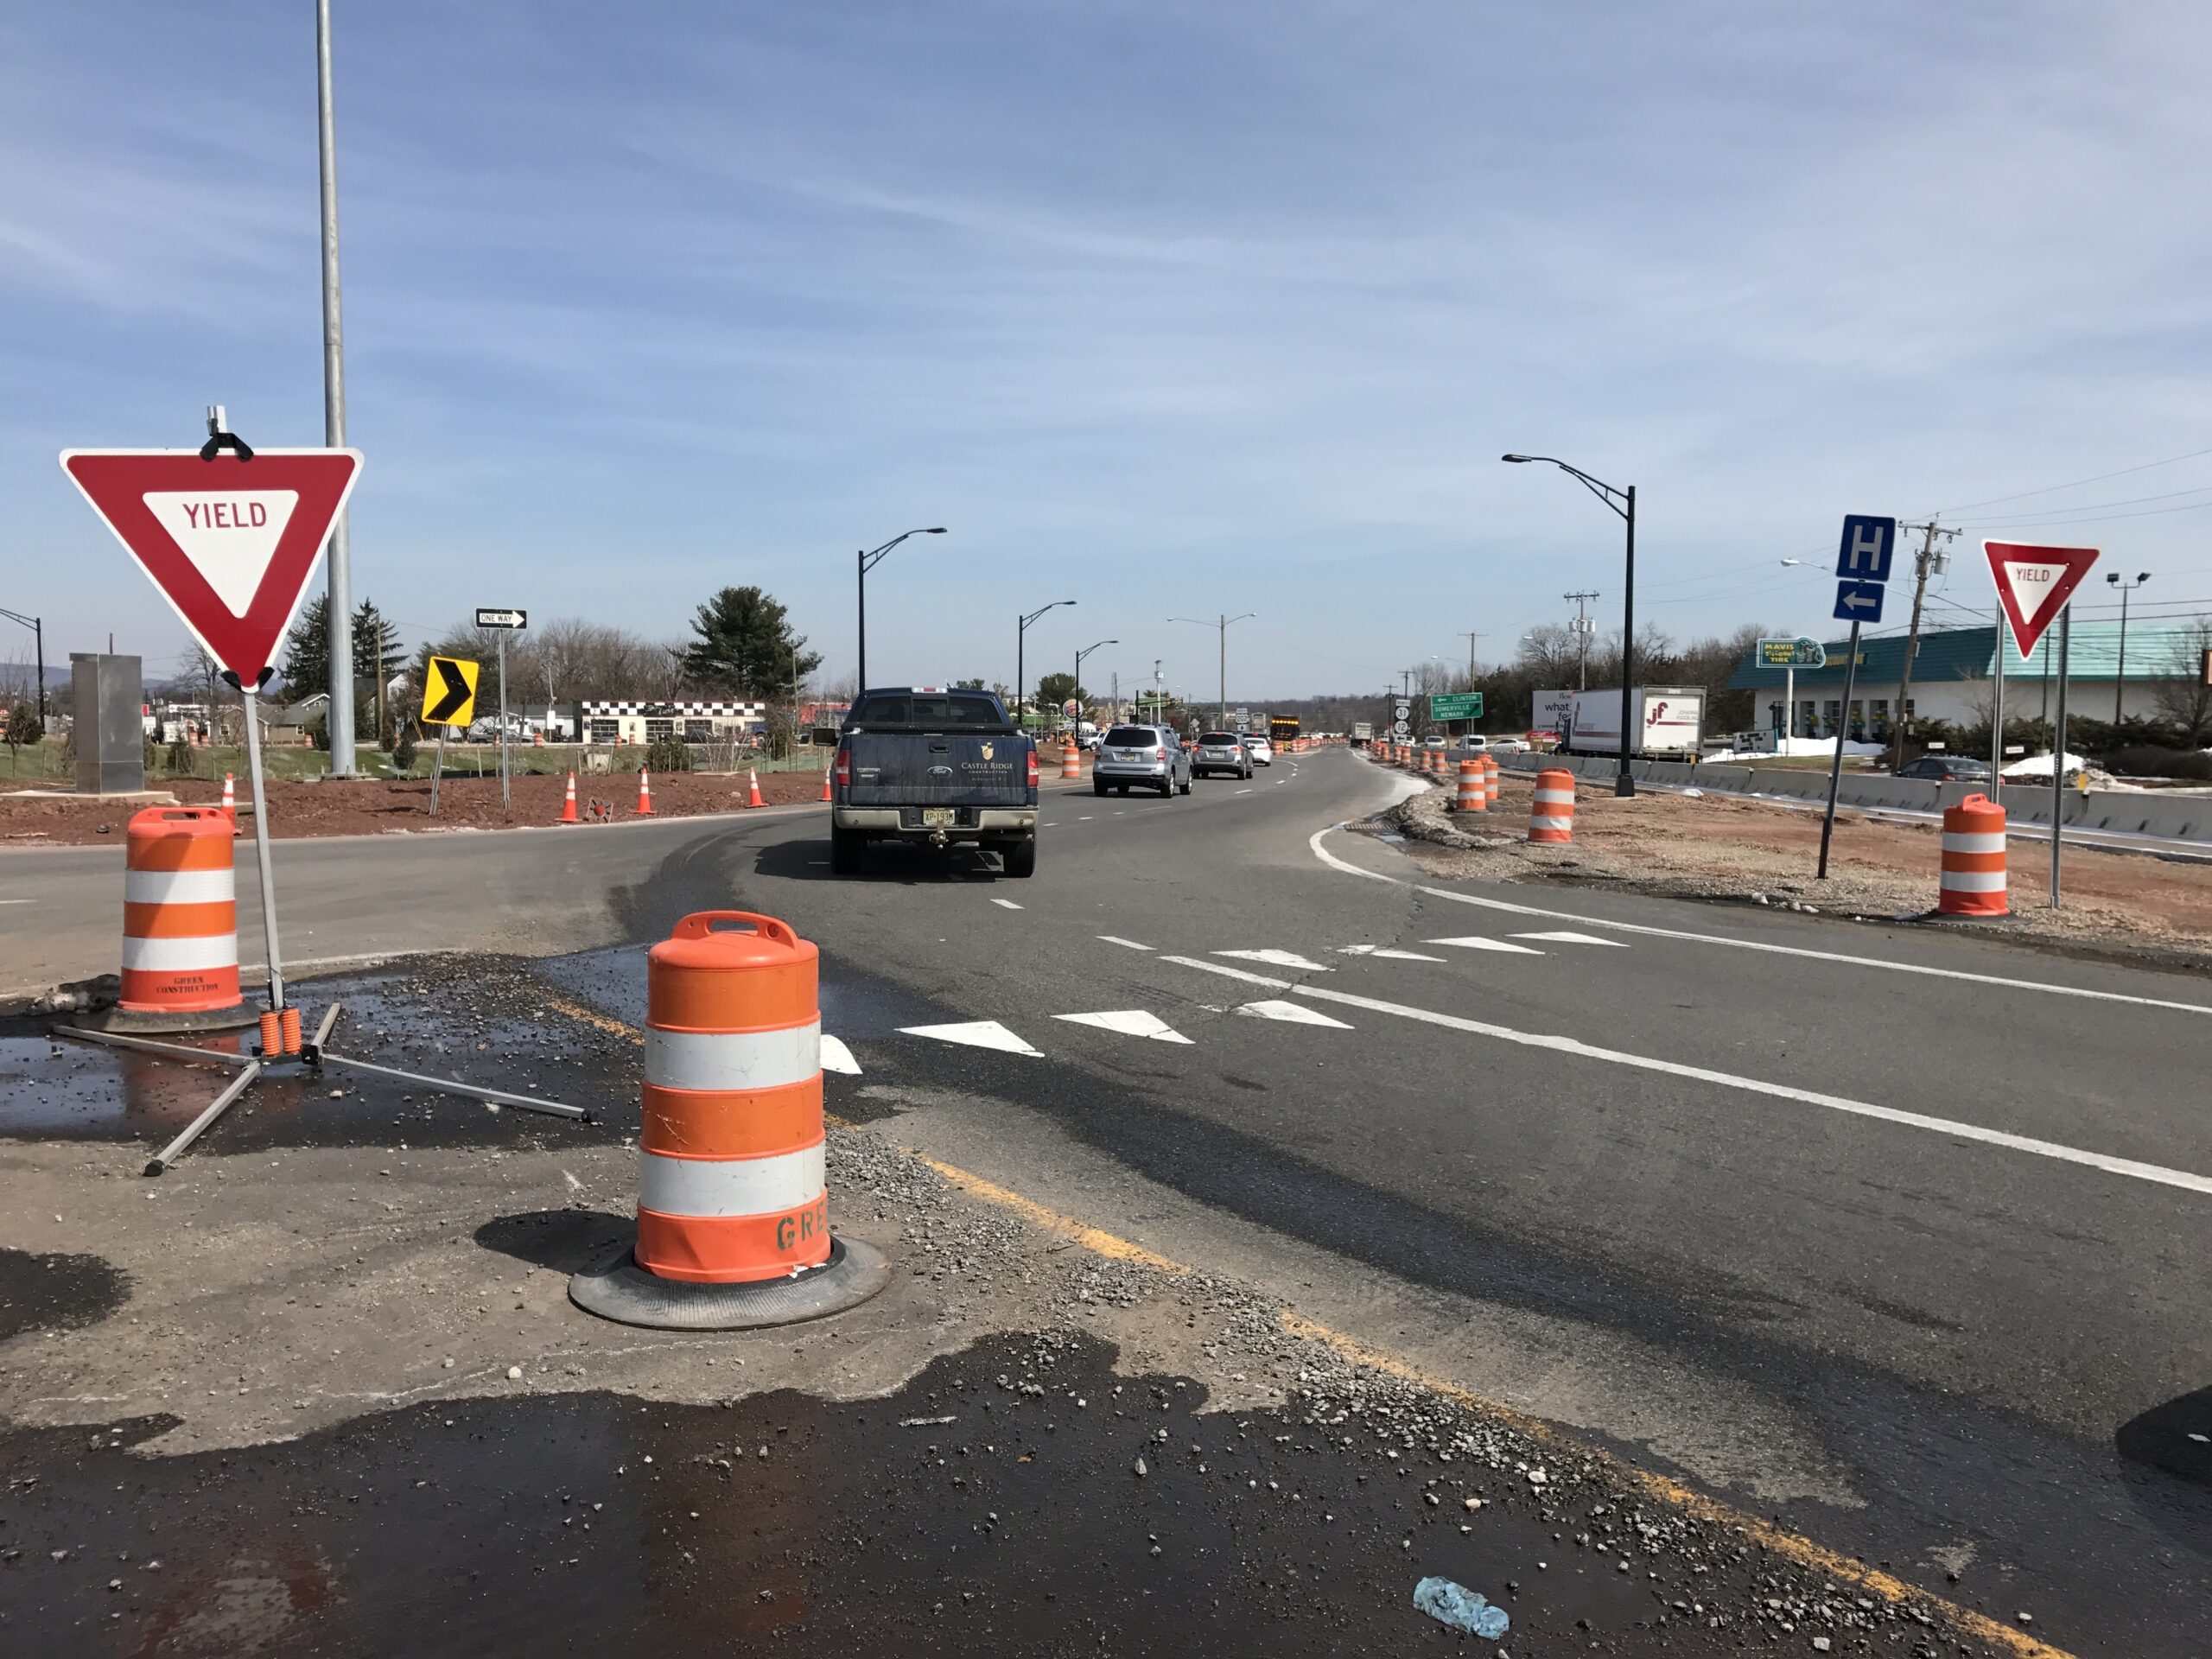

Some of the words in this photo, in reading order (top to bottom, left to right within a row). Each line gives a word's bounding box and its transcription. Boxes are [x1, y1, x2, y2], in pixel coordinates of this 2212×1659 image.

[181, 502, 267, 529] YIELD
[1849, 524, 1884, 571] H
[2016, 568, 2050, 582] YIELD
[480, 613, 496, 622] ONE
[497, 614, 512, 623] WAY
[1397, 709, 1407, 718] 31
[1434, 704, 1471, 713] SOMERVILLE
[1236, 714, 1248, 722] 202
[1397, 722, 1406, 731] 12
[174, 976, 204, 985] GREEN
[156, 983, 219, 994] CONSTRUCTION
[777, 1202, 826, 1251] GRE
